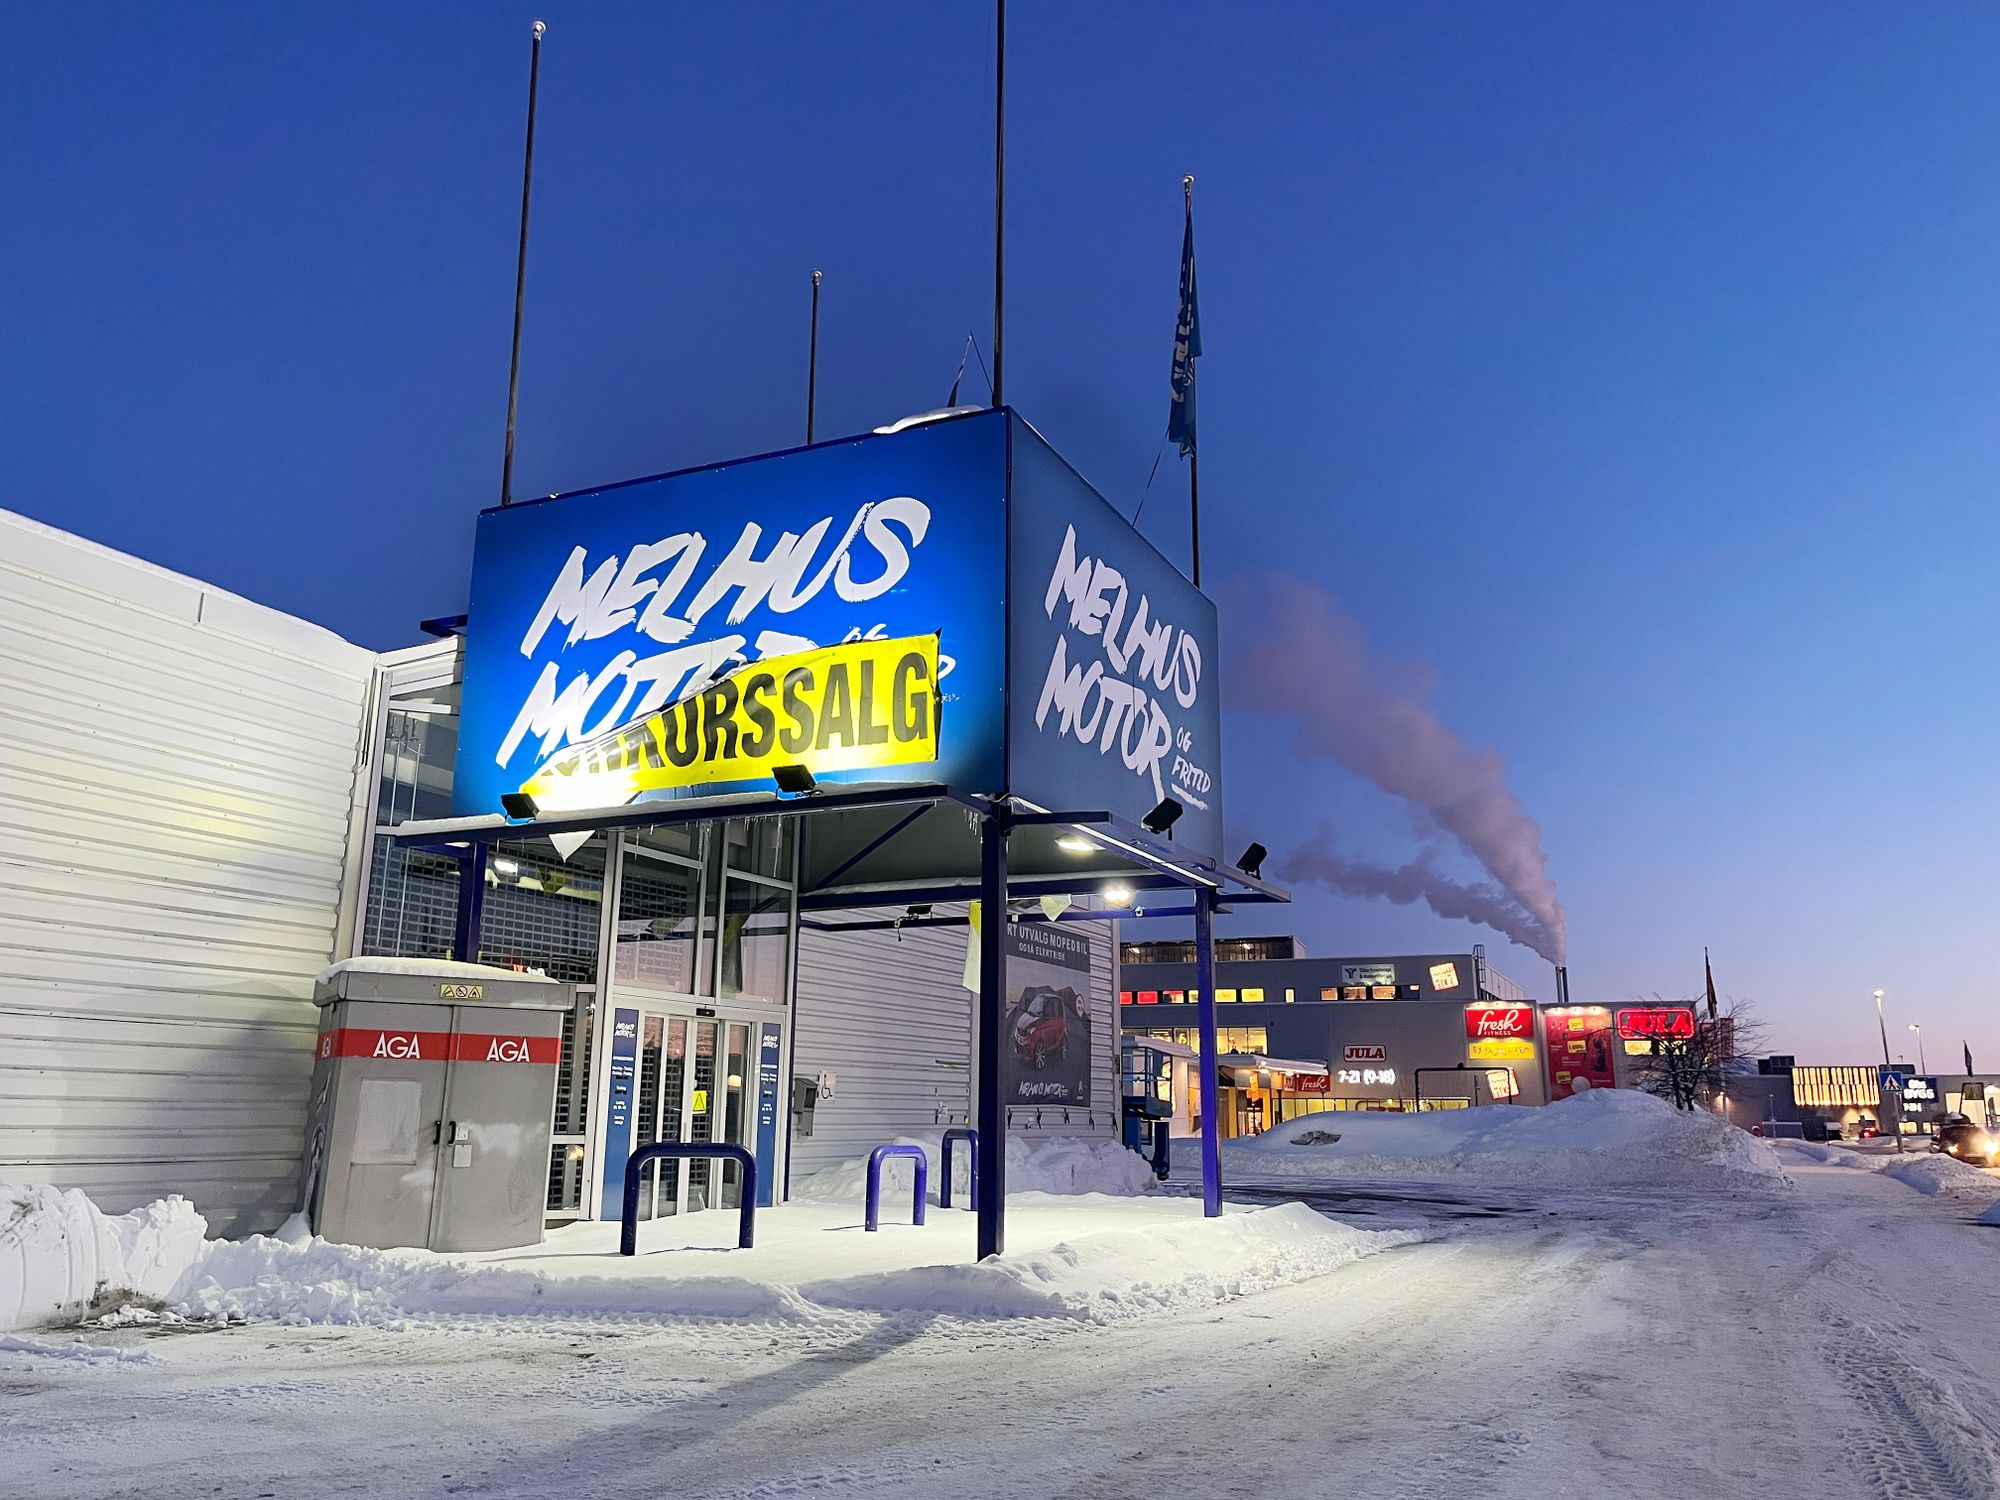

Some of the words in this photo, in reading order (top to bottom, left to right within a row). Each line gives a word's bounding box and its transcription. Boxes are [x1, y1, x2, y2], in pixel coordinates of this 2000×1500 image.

[520, 497, 931, 659] MELHUS
[1045, 524, 1201, 709] MELHUS
[495, 630, 822, 770] MOT
[1036, 634, 1172, 805] MOTOR
[1176, 727, 1193, 753] OG
[1172, 755, 1211, 793] FRITID
[1020, 926, 1049, 945] UTVALG
[1049, 933, 1088, 955] MOPEDBIL
[1476, 1010, 1523, 1036] fresh
[1623, 1013, 1689, 1034] JULA
[372, 1031, 421, 1059] AGA
[485, 1037, 530, 1062] AGA
[1345, 1048, 1384, 1059] JULA
[1301, 1076, 1327, 1091] fresh
[1337, 1069, 1361, 1084] 7-21
[1363, 1068, 1396, 1085] (9-18)
[1903, 1088, 1935, 1099] BYGG
